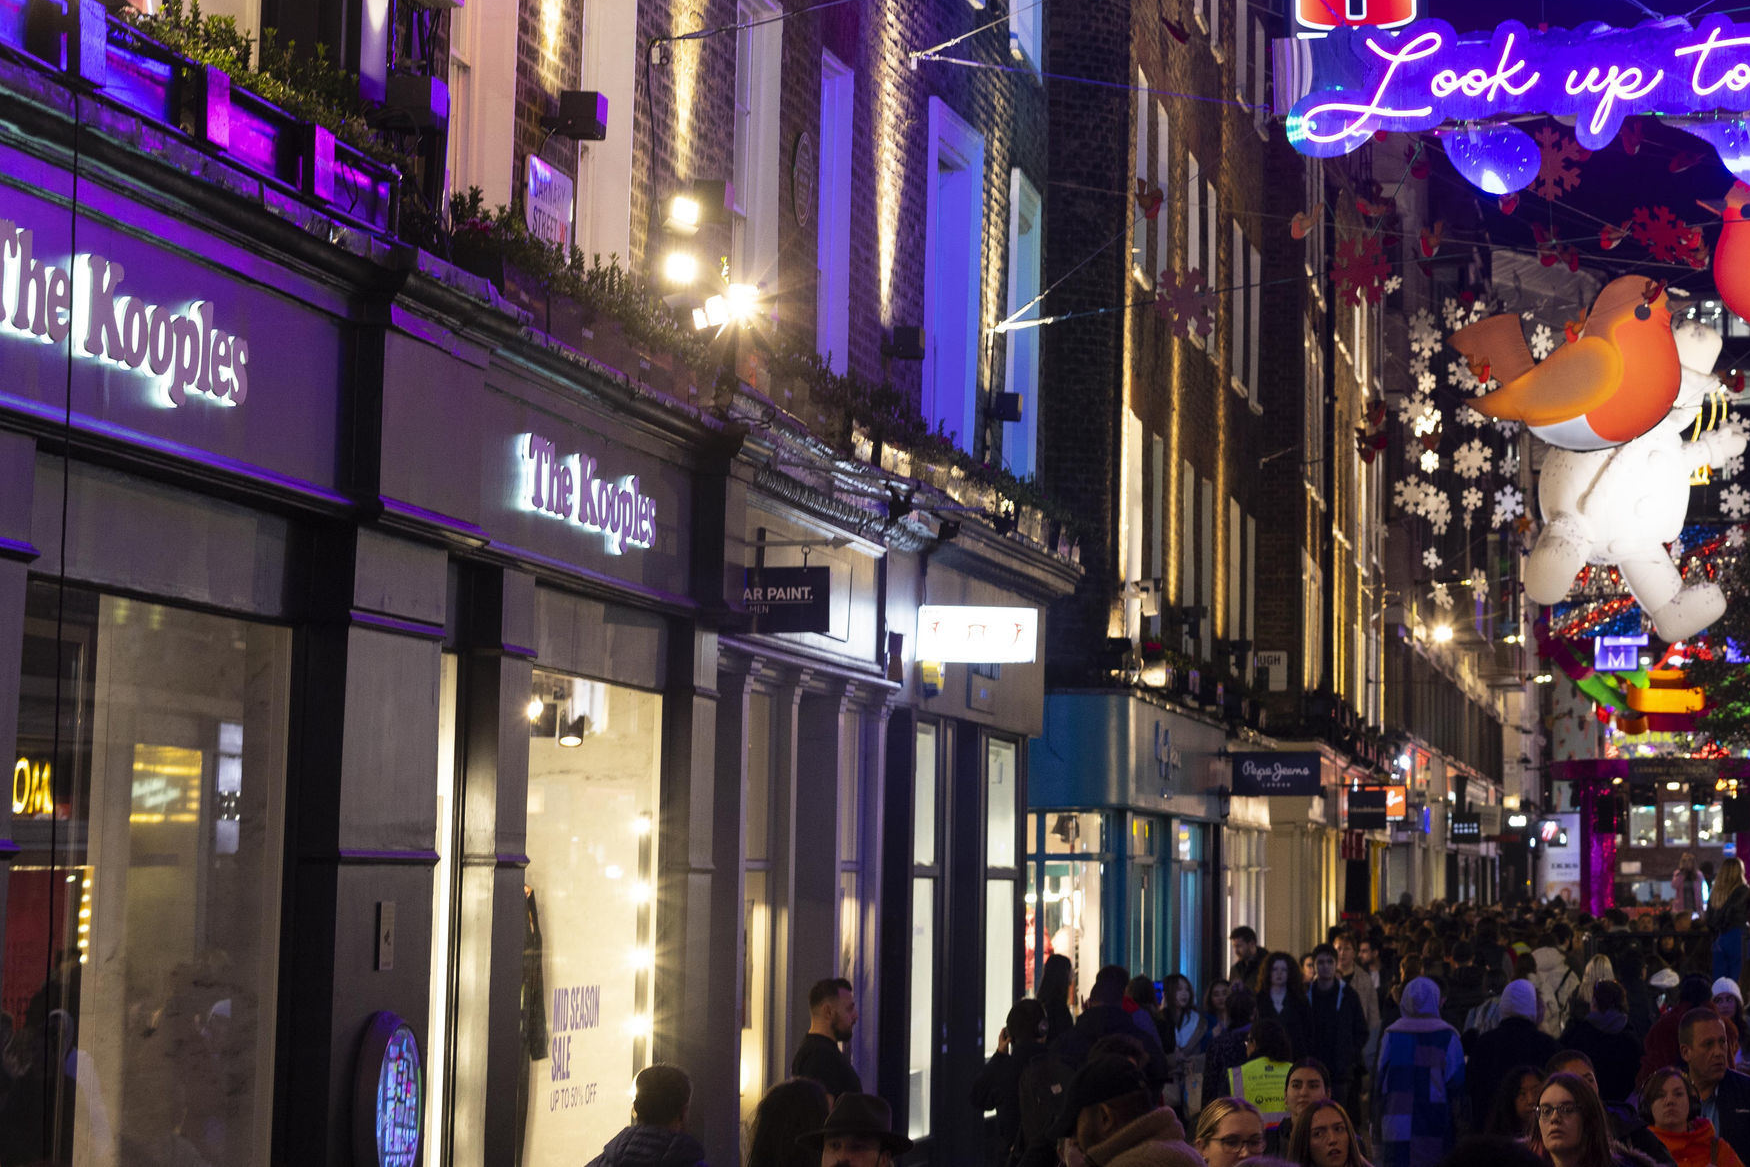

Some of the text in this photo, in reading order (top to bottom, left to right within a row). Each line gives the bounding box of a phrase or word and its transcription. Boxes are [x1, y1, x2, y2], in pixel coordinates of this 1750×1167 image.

[1301, 31, 1541, 144] Look
[1564, 64, 1665, 135] up
[82, 253, 249, 408] Kooples
[528, 433, 657, 554] The Kooples
[743, 586, 813, 601] AR PAINT.
[553, 984, 600, 1033] MID SEASON
[551, 1035, 571, 1082] SALE
[550, 1089, 560, 1112] UP
[561, 1087, 570, 1110] TO
[585, 1082, 598, 1104] OFF
